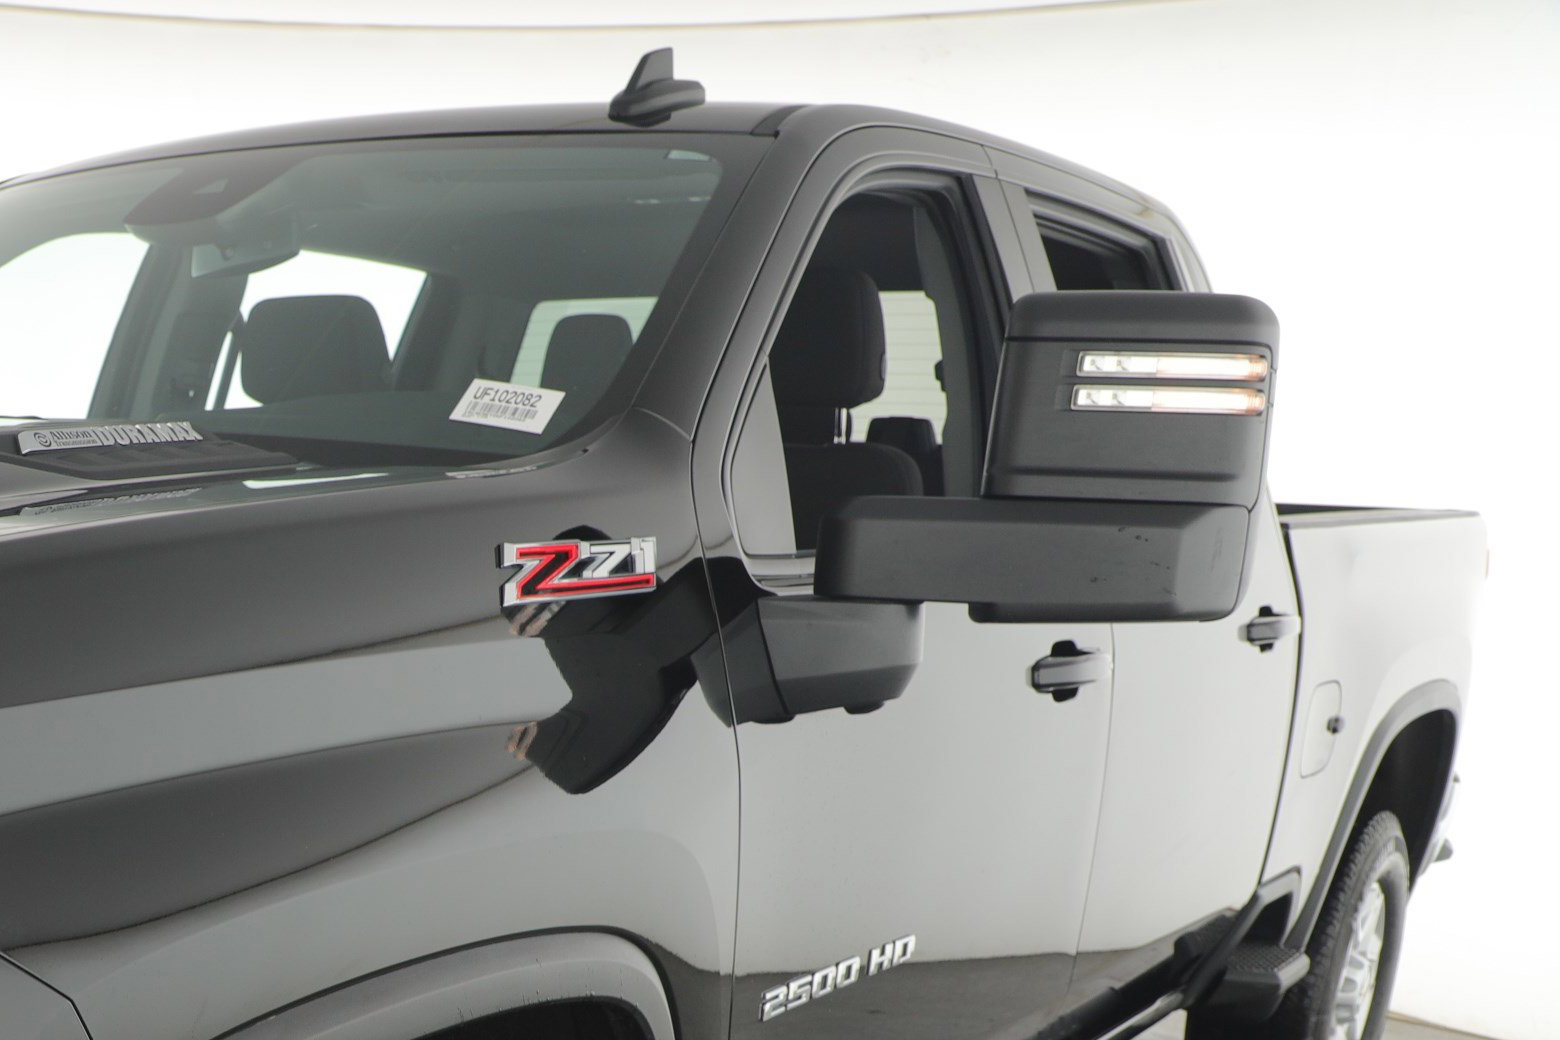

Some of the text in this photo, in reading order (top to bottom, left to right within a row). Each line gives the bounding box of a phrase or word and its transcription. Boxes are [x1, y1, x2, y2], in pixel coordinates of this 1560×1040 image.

[473, 386, 542, 408] UF102082
[92, 421, 203, 446] DURAMAX
[495, 536, 657, 607] Z71
[760, 934, 916, 1022] 2500 HD
